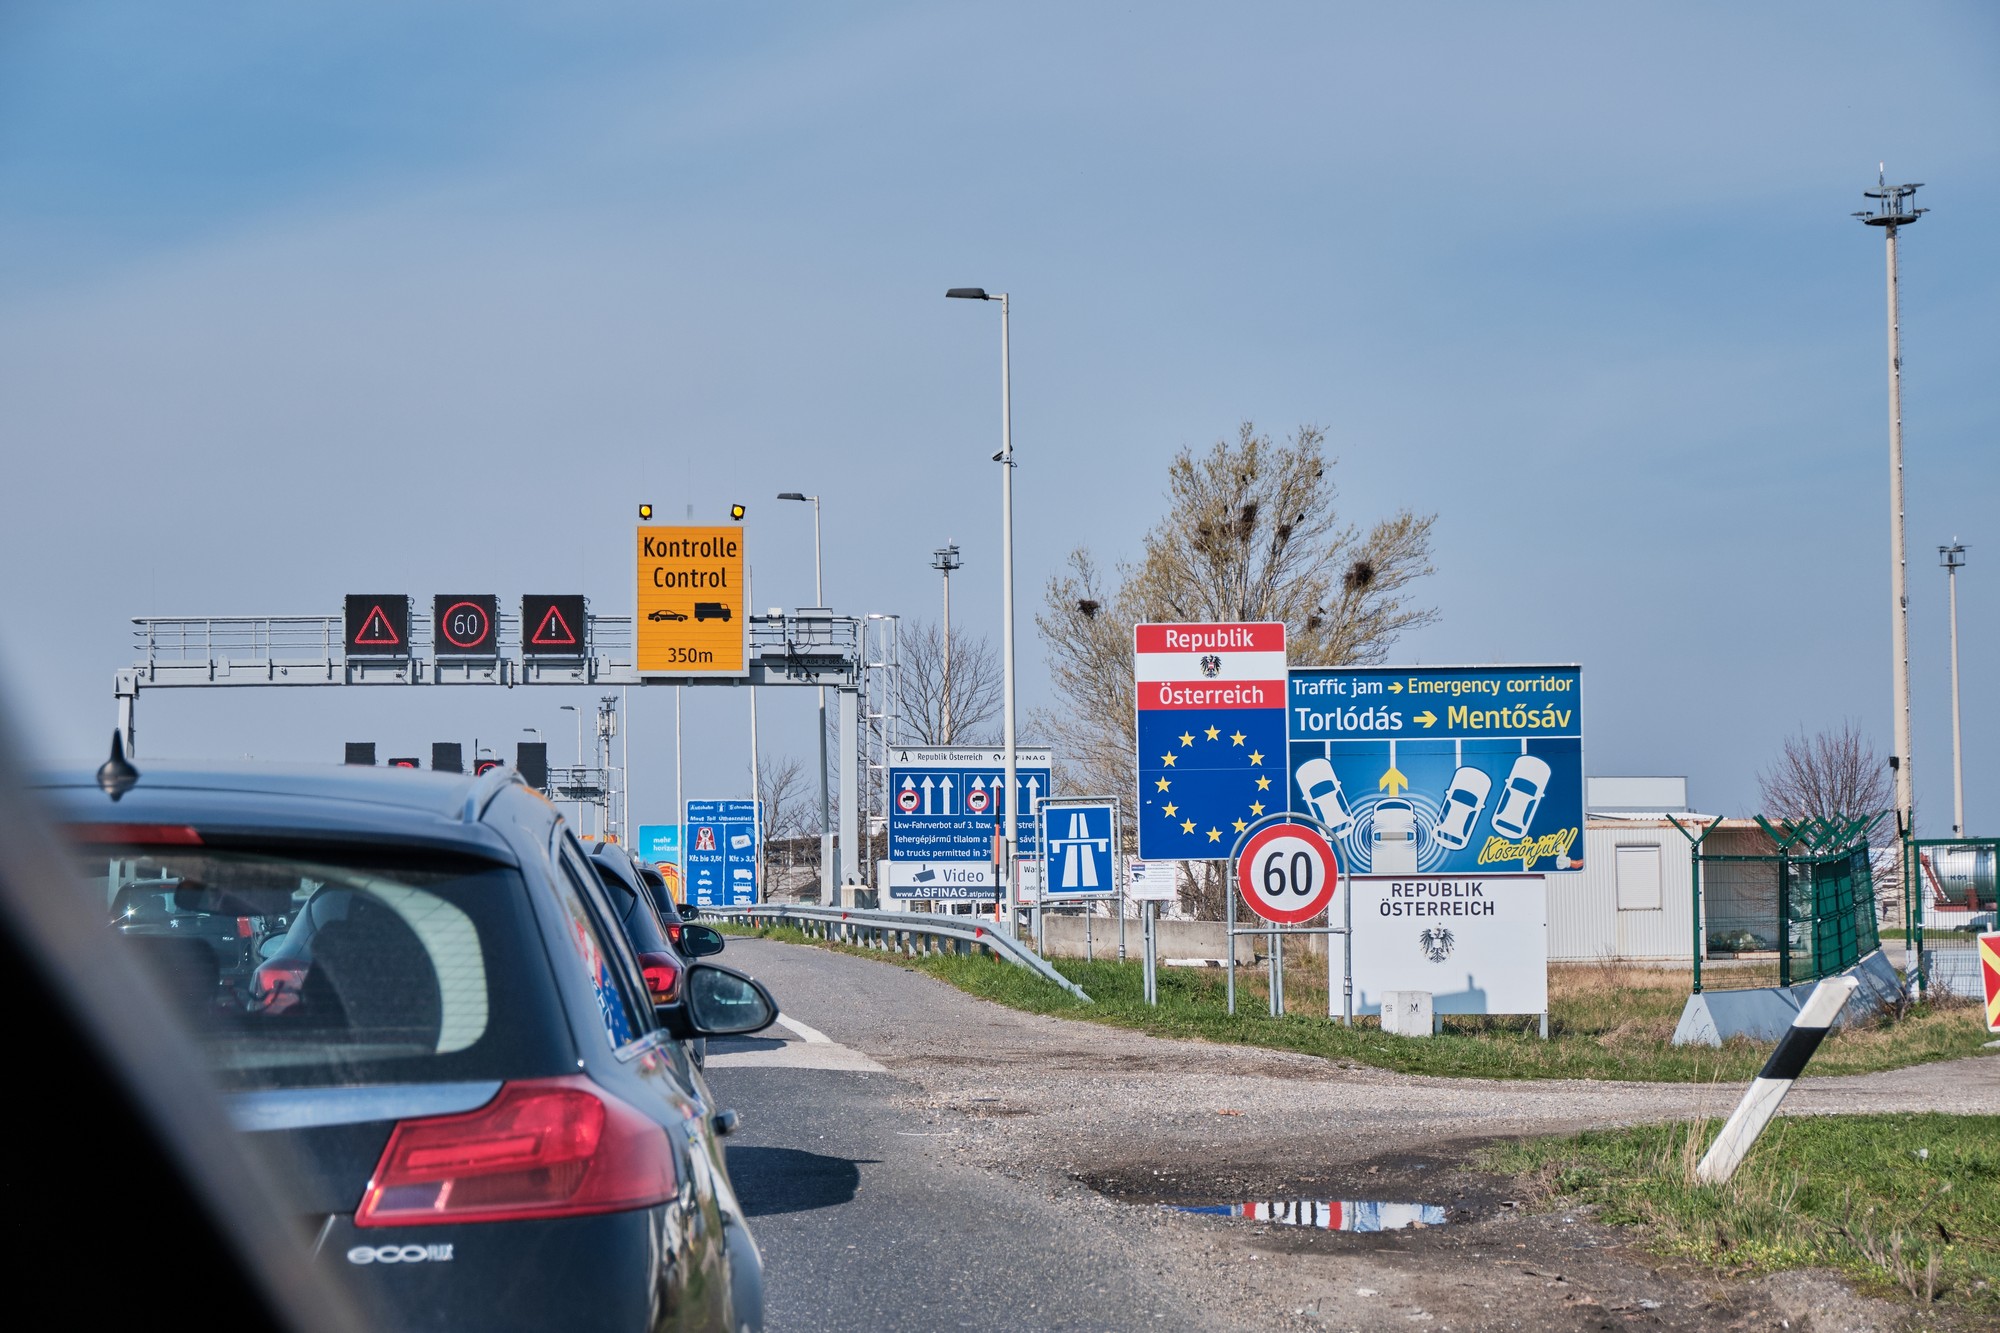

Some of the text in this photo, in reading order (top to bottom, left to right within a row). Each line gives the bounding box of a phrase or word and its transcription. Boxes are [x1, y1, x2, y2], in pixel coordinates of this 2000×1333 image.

[644, 536, 736, 558] Kontrolle
[654, 567, 727, 588] Control
[454, 614, 477, 634] 60
[1166, 628, 1254, 651] Republik
[668, 648, 713, 662] 350m
[1160, 682, 1264, 704] Österreich
[1292, 676, 1573, 698] Traffic jam Emergency corridor
[1294, 702, 1572, 731] Torlódás Mentősáv
[900, 751, 983, 764] A Republik Österreich
[894, 821, 952, 829] Lkw-Fahrverbot
[954, 821, 966, 829] auf
[894, 836, 951, 844] Tehergépjármű
[1478, 828, 1577, 866] Köszönjük!
[933, 850, 970, 858] permitted
[943, 869, 984, 883] Video
[1263, 851, 1313, 896] 60
[896, 888, 1003, 899] www.ASFINAG.at/privay
[1392, 882, 1484, 898] REPUBLIK
[1380, 898, 1494, 916] ÖSTERREICH
[1411, 1003, 1418, 1012] M
